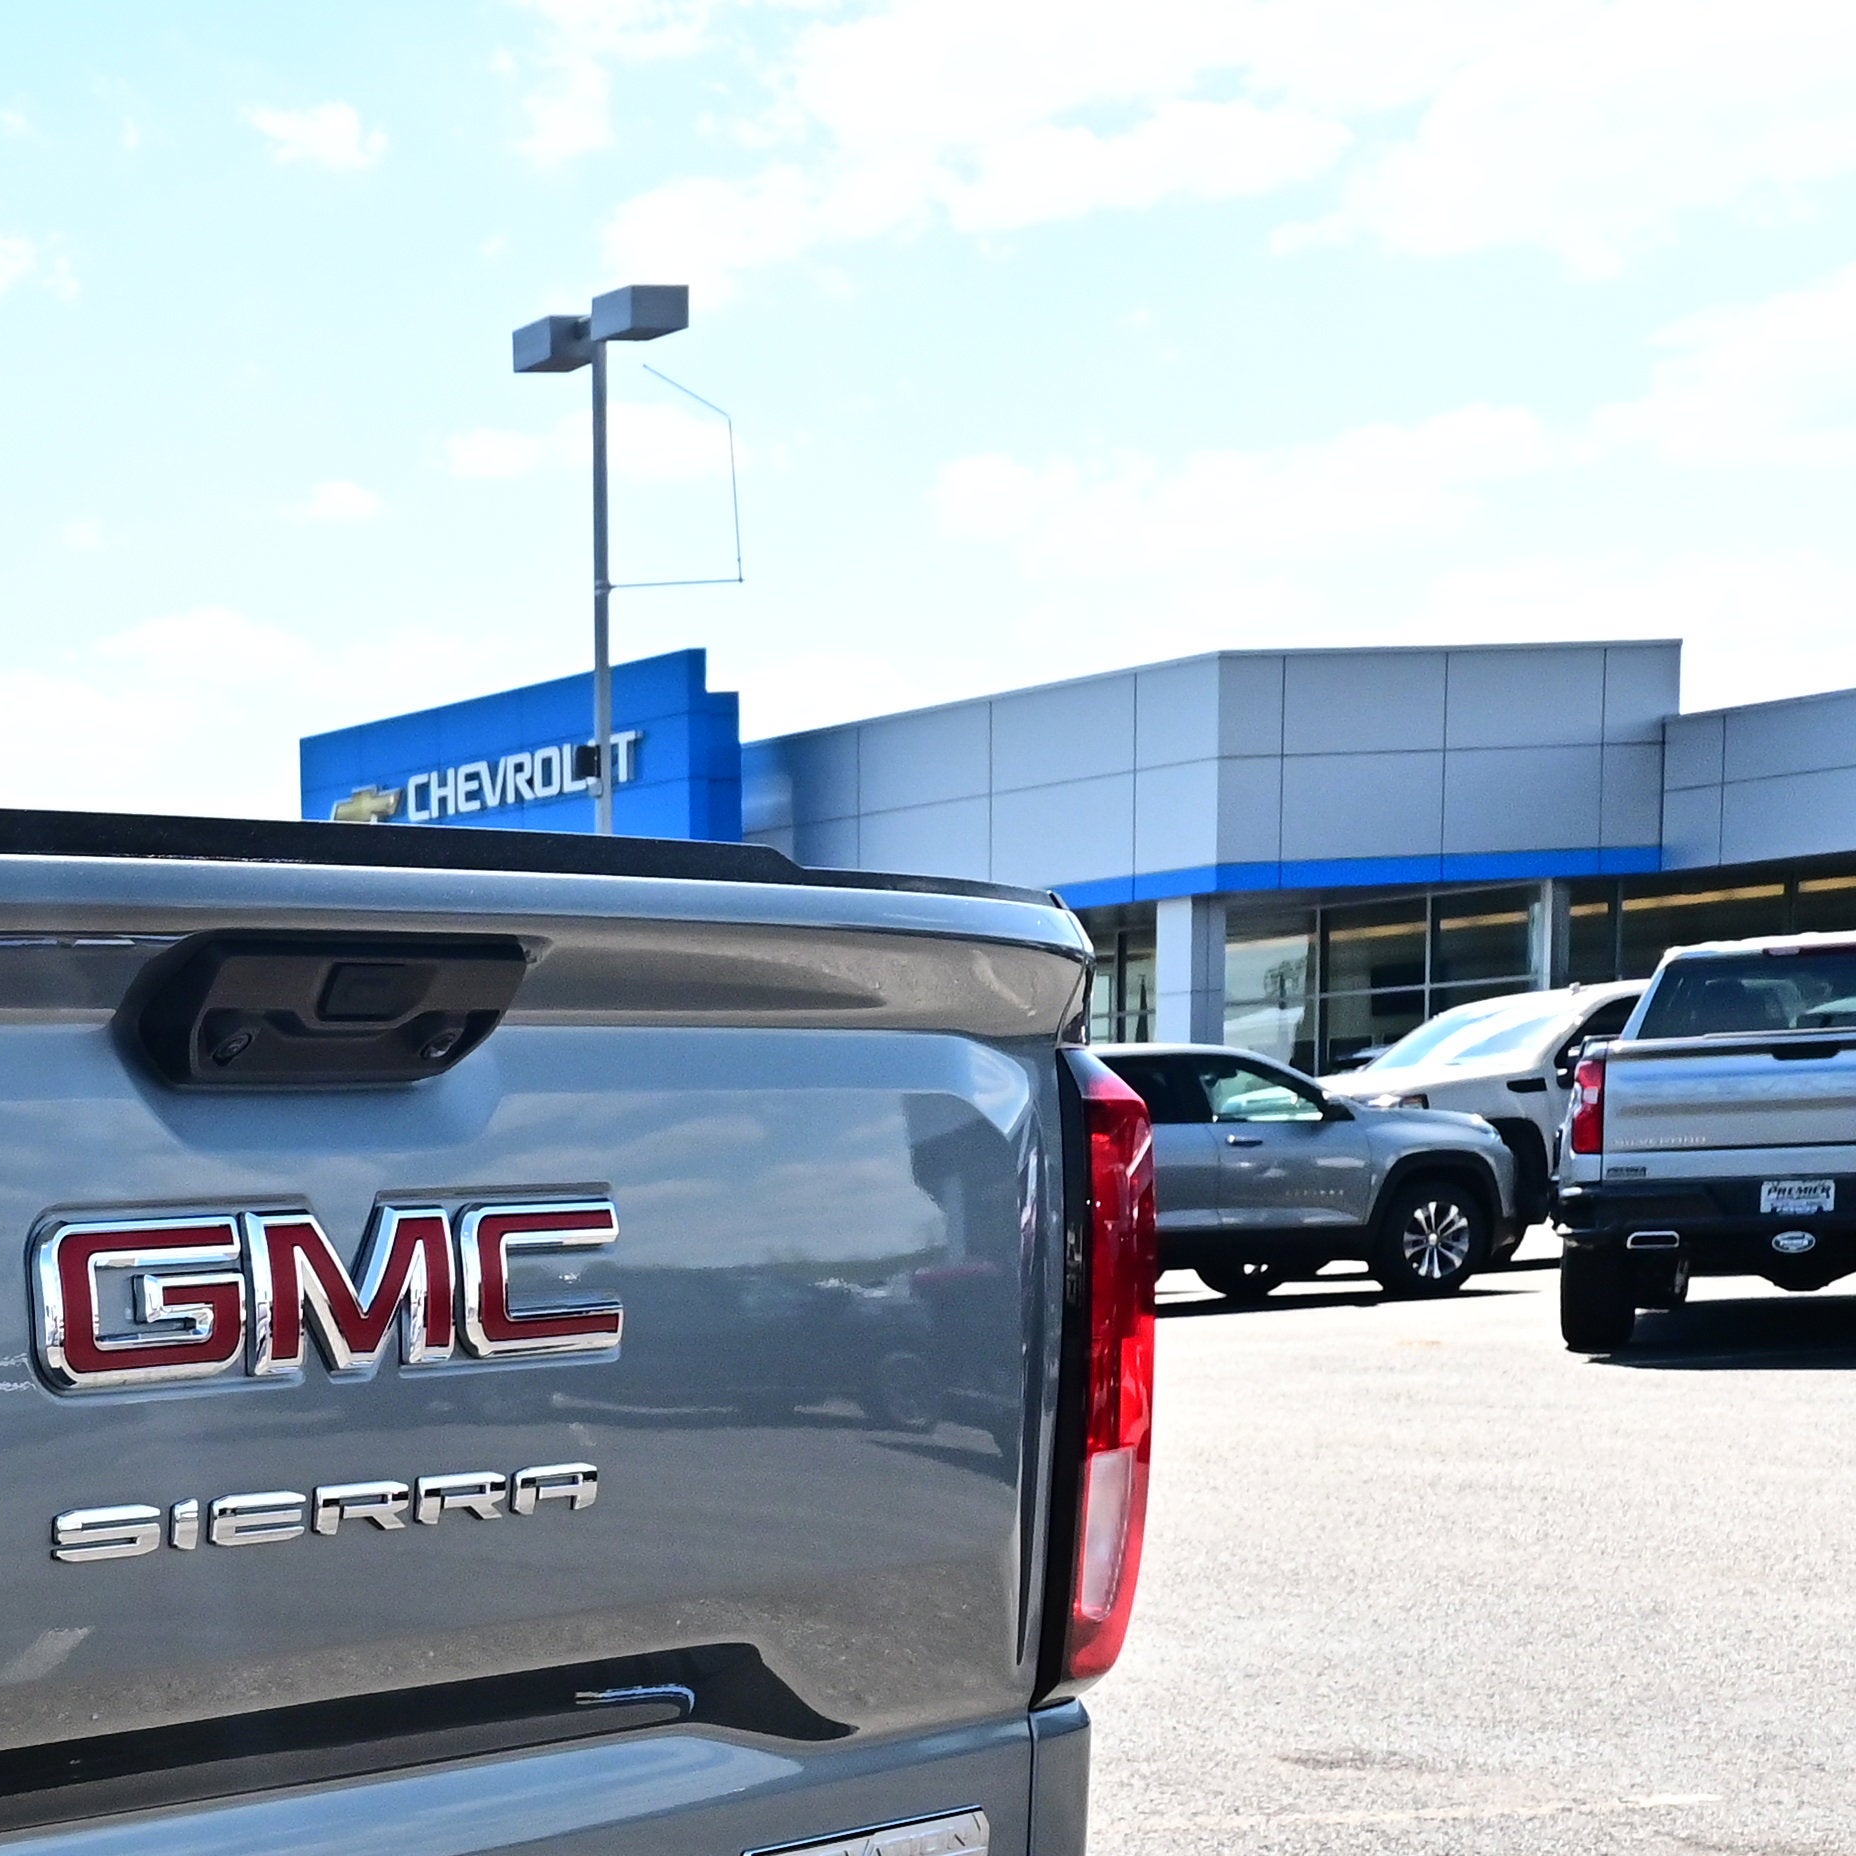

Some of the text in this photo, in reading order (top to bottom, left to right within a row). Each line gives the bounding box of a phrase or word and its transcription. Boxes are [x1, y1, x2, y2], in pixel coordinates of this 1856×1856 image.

[407, 730, 638, 822] CHEVROLT
[38, 1200, 625, 1390] GMC
[50, 1461, 598, 1563] SIERRA
